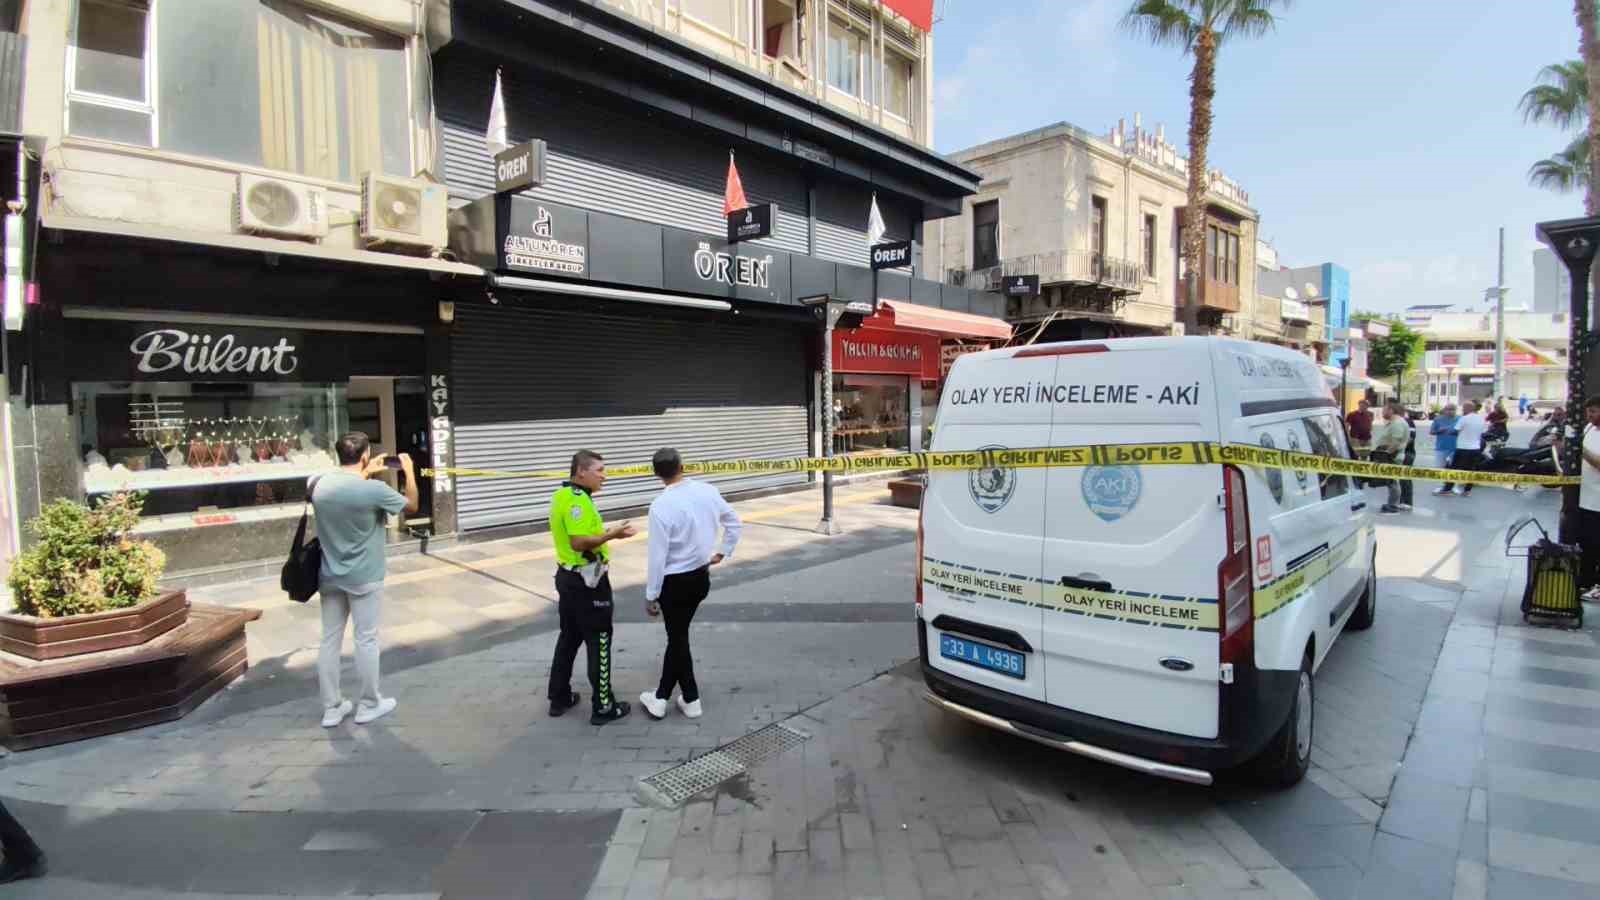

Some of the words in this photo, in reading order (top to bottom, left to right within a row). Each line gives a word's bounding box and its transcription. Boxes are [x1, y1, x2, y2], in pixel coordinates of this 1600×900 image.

[498, 154, 528, 182] ÖREN
[694, 242, 769, 289] ÖREN
[874, 247, 905, 262] ÖREN
[130, 329, 298, 374] Bülent
[951, 387, 988, 405] OLAY
[992, 382, 1031, 404] YERİ
[1035, 381, 1138, 404] İNCELEME
[1158, 381, 1200, 405] AKİ
[431, 374, 452, 493] KAYADELEN
[930, 568, 950, 579] OLAY
[974, 576, 1024, 595] İNCELEME
[1063, 593, 1094, 607] OLAY
[1097, 598, 1127, 612] YERİ
[1130, 601, 1199, 620] İNCELEME
[950, 639, 965, 656] 33
[987, 648, 1019, 672] 4936
